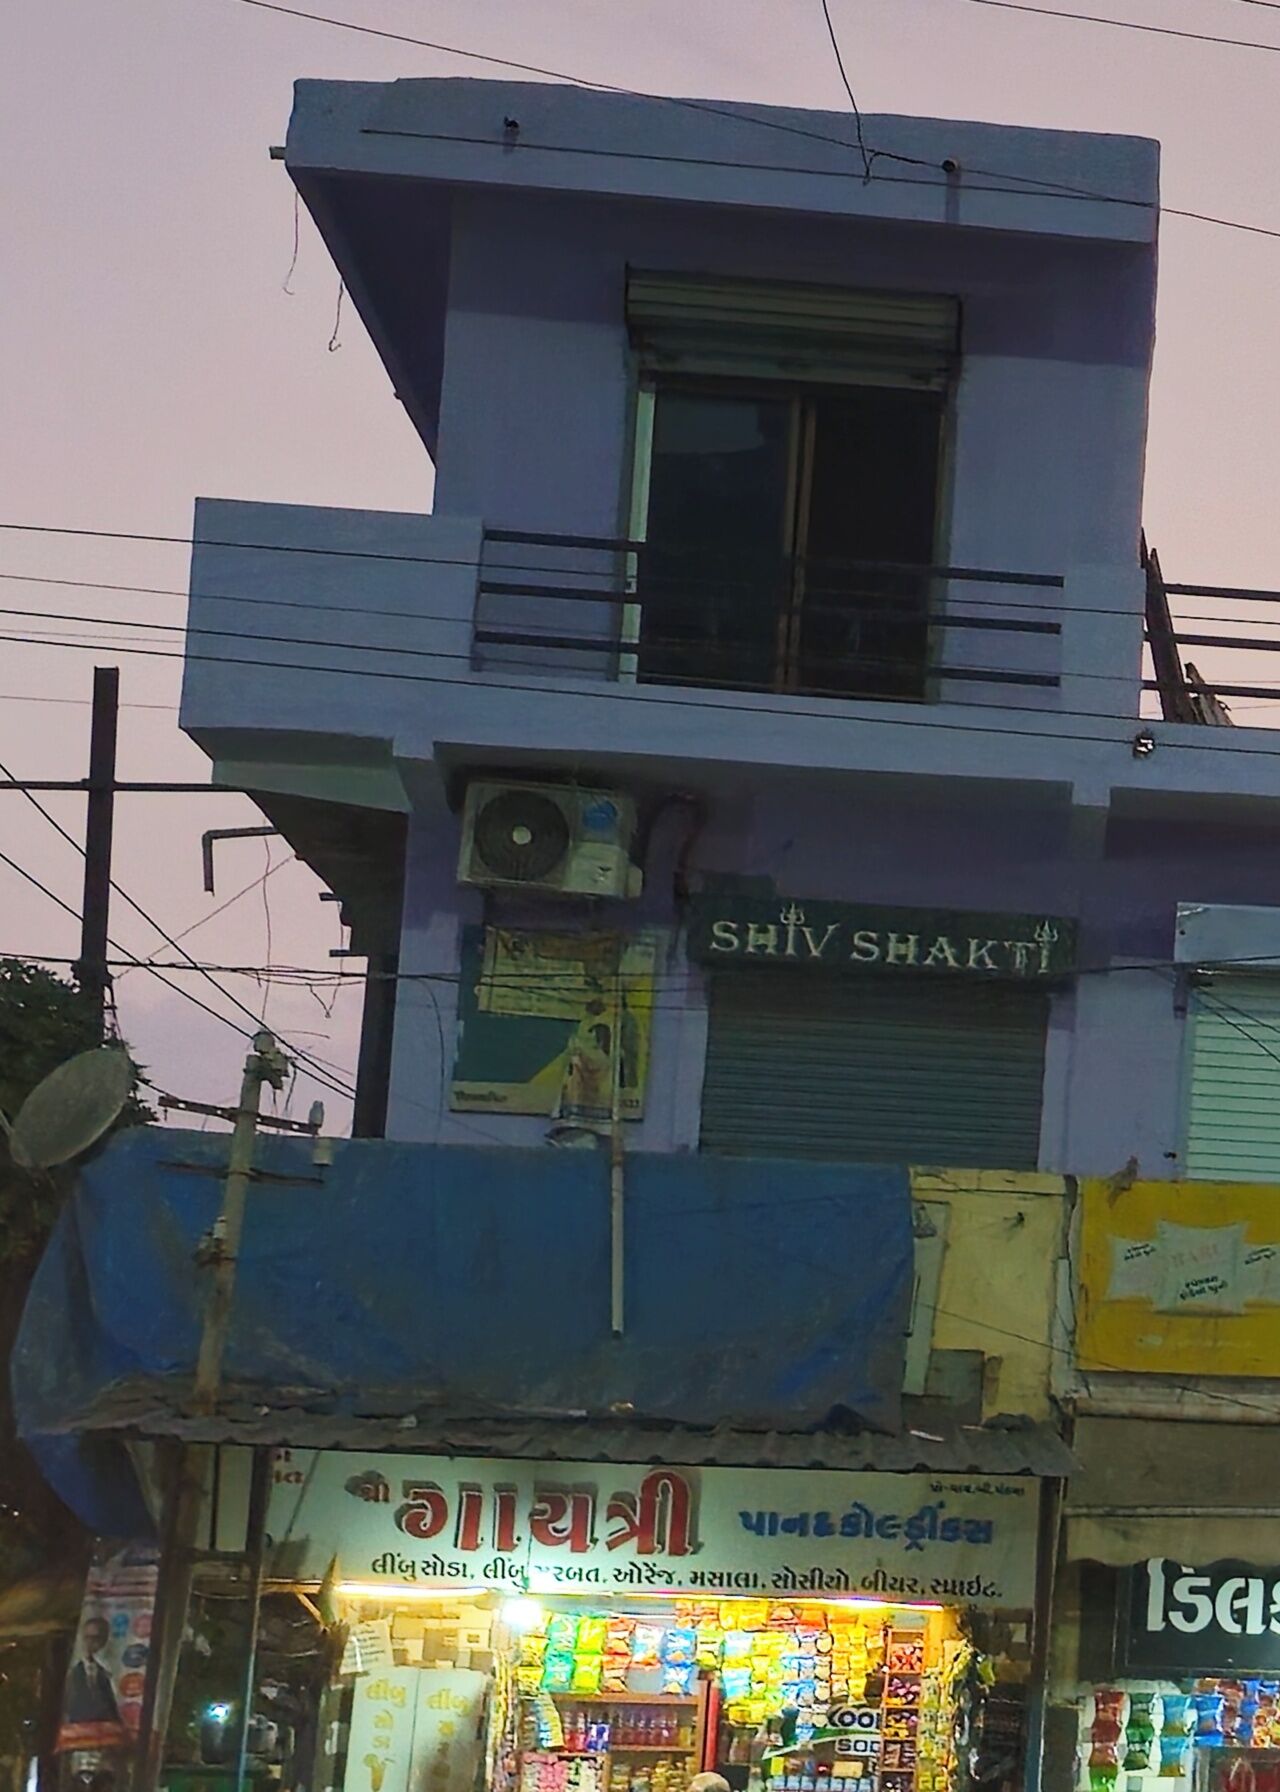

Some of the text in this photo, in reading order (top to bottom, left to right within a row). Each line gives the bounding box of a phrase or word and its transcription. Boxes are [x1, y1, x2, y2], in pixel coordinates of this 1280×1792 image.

[710, 902, 1058, 974] SHIV SHAKTI
[402, 1469, 695, 1556] ગાયત્રી
